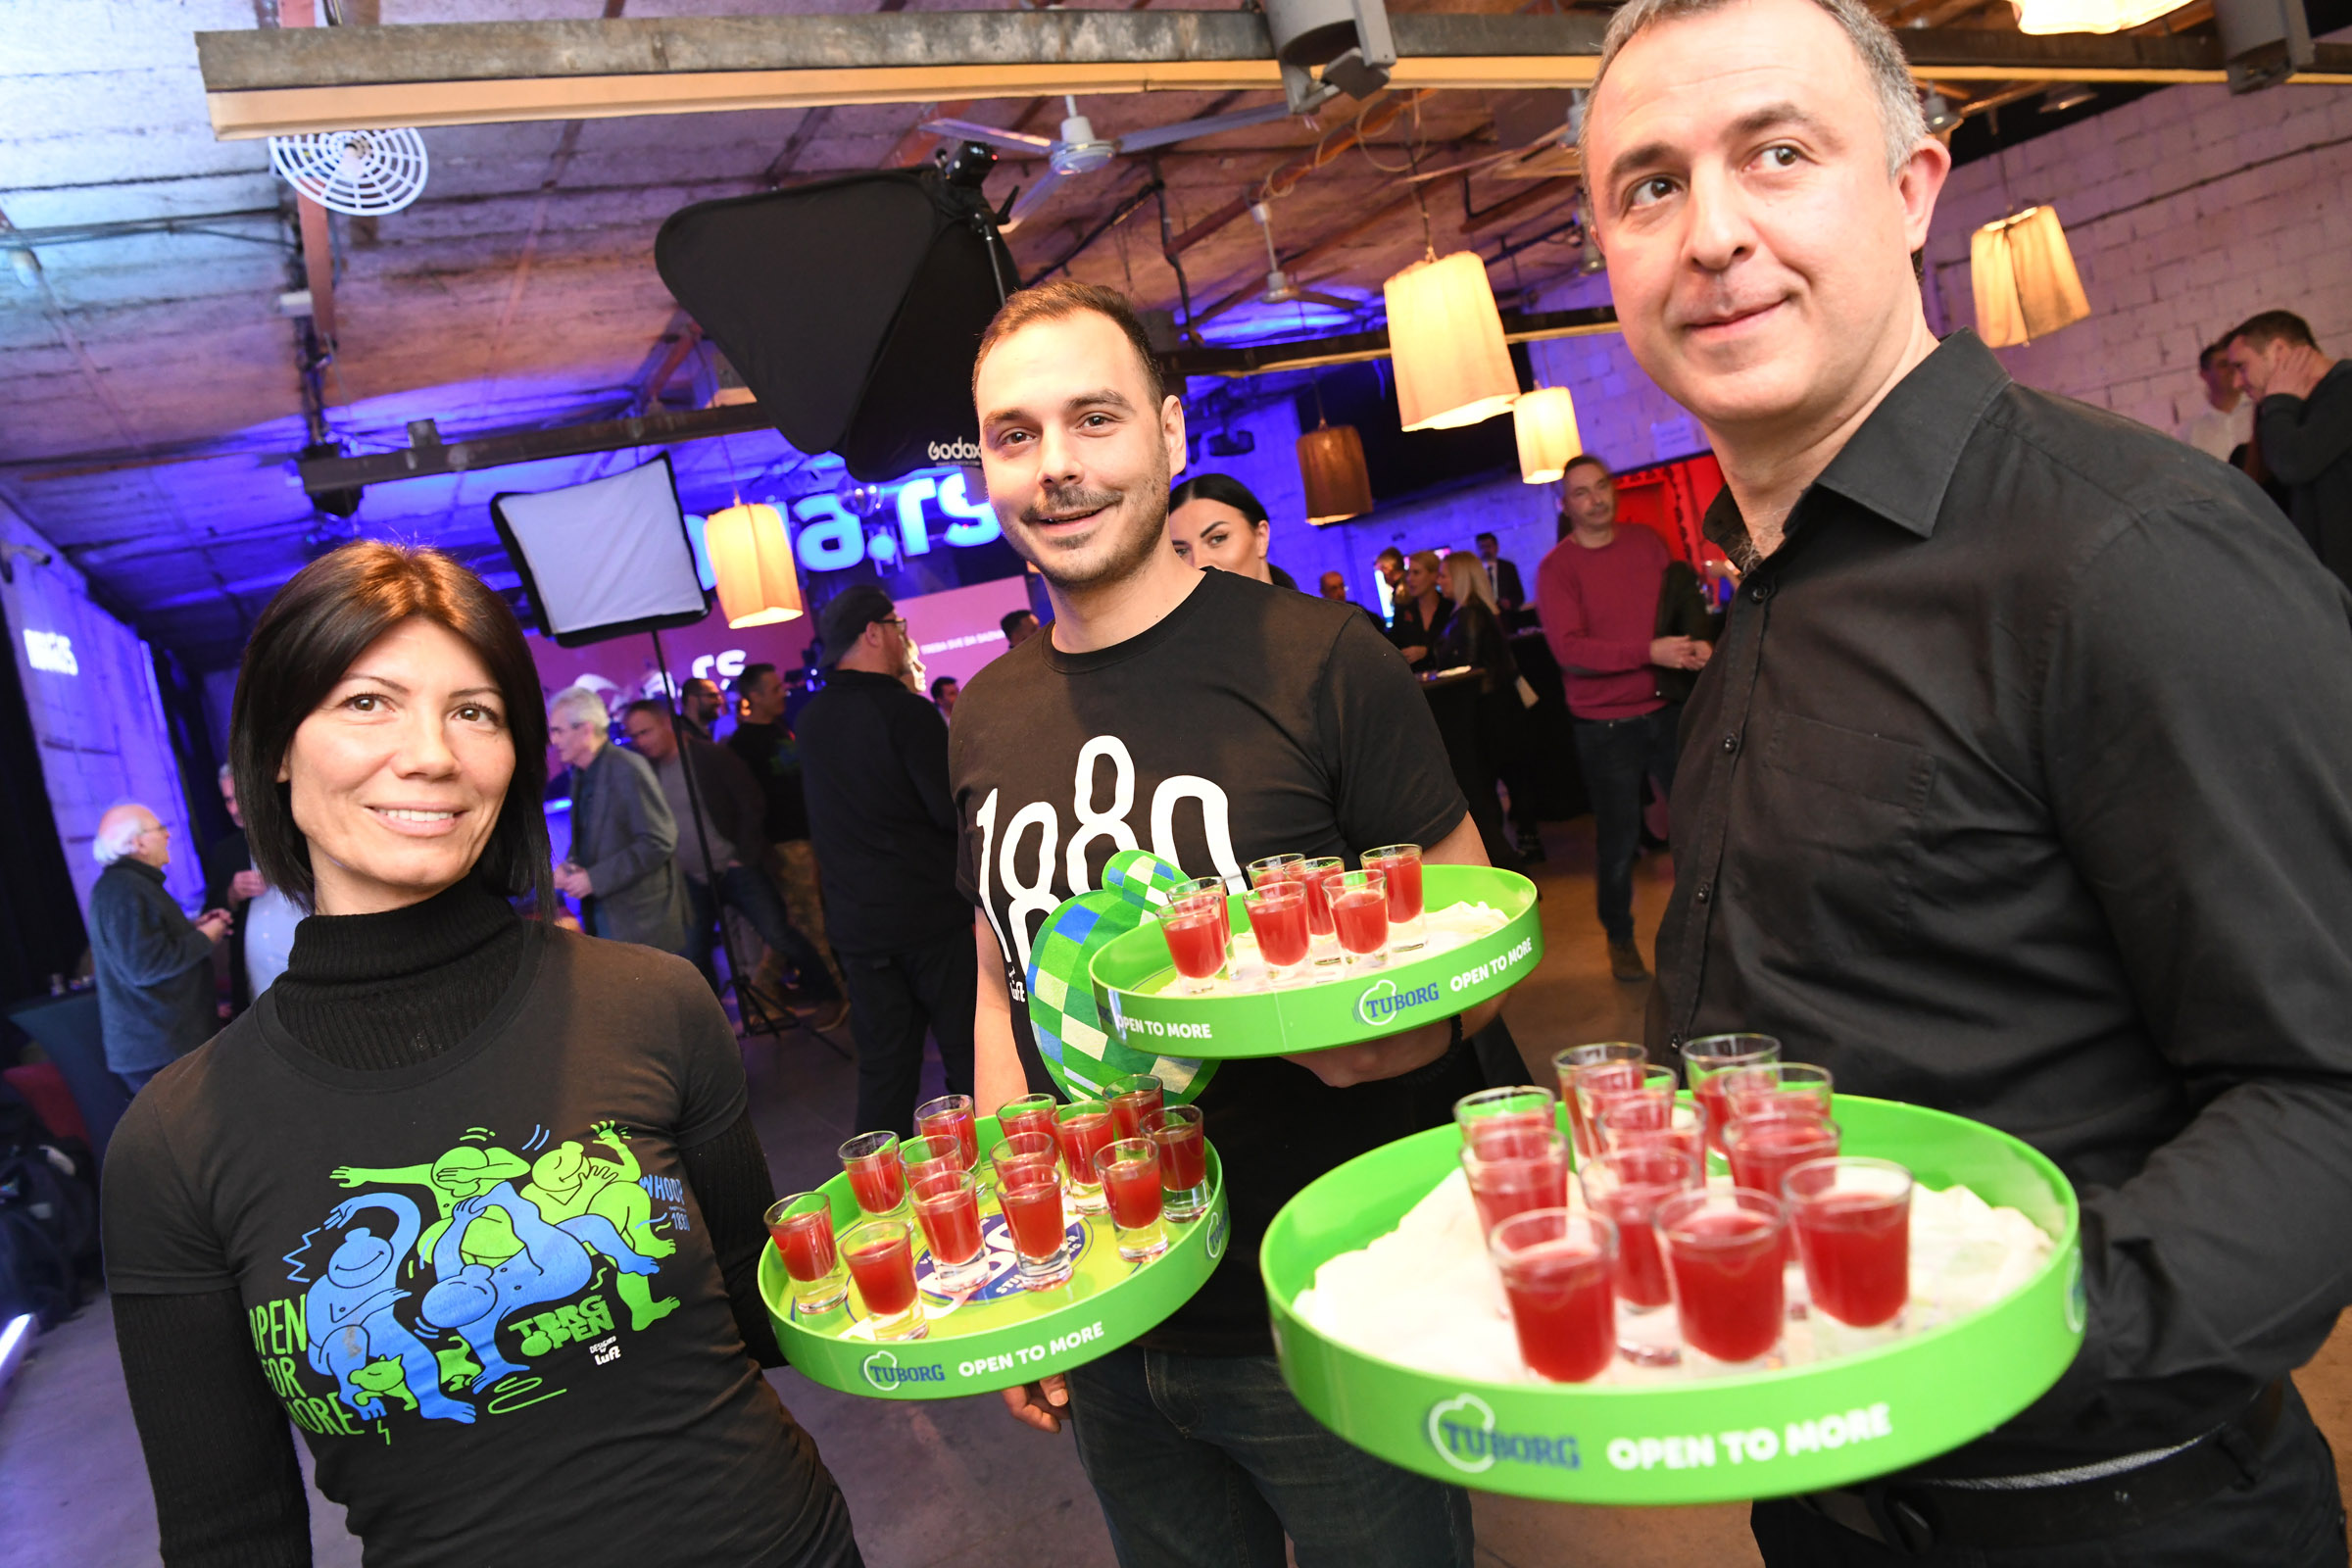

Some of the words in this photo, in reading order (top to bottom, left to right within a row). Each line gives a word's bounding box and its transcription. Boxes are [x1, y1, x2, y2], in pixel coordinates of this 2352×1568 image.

[927, 435, 984, 461] Godox
[1366, 982, 1440, 1018] TUBORG
[1450, 964, 1490, 992] OPEN
[1490, 955, 1507, 974] TO
[1508, 937, 1533, 965] MORE
[1117, 1014, 1145, 1034] OPEN
[1145, 1020, 1164, 1036] TO
[1166, 1022, 1212, 1039] MORE
[870, 1364, 945, 1383] TUBORG
[958, 1353, 1013, 1378] OPEN
[1016, 1345, 1046, 1365] TO
[1050, 1321, 1104, 1355] MORE
[1443, 1420, 1581, 1470] TUBORG
[1607, 1435, 1716, 1470] OPEN
[1719, 1427, 1780, 1464] TO
[1785, 1401, 1892, 1456] MORE
